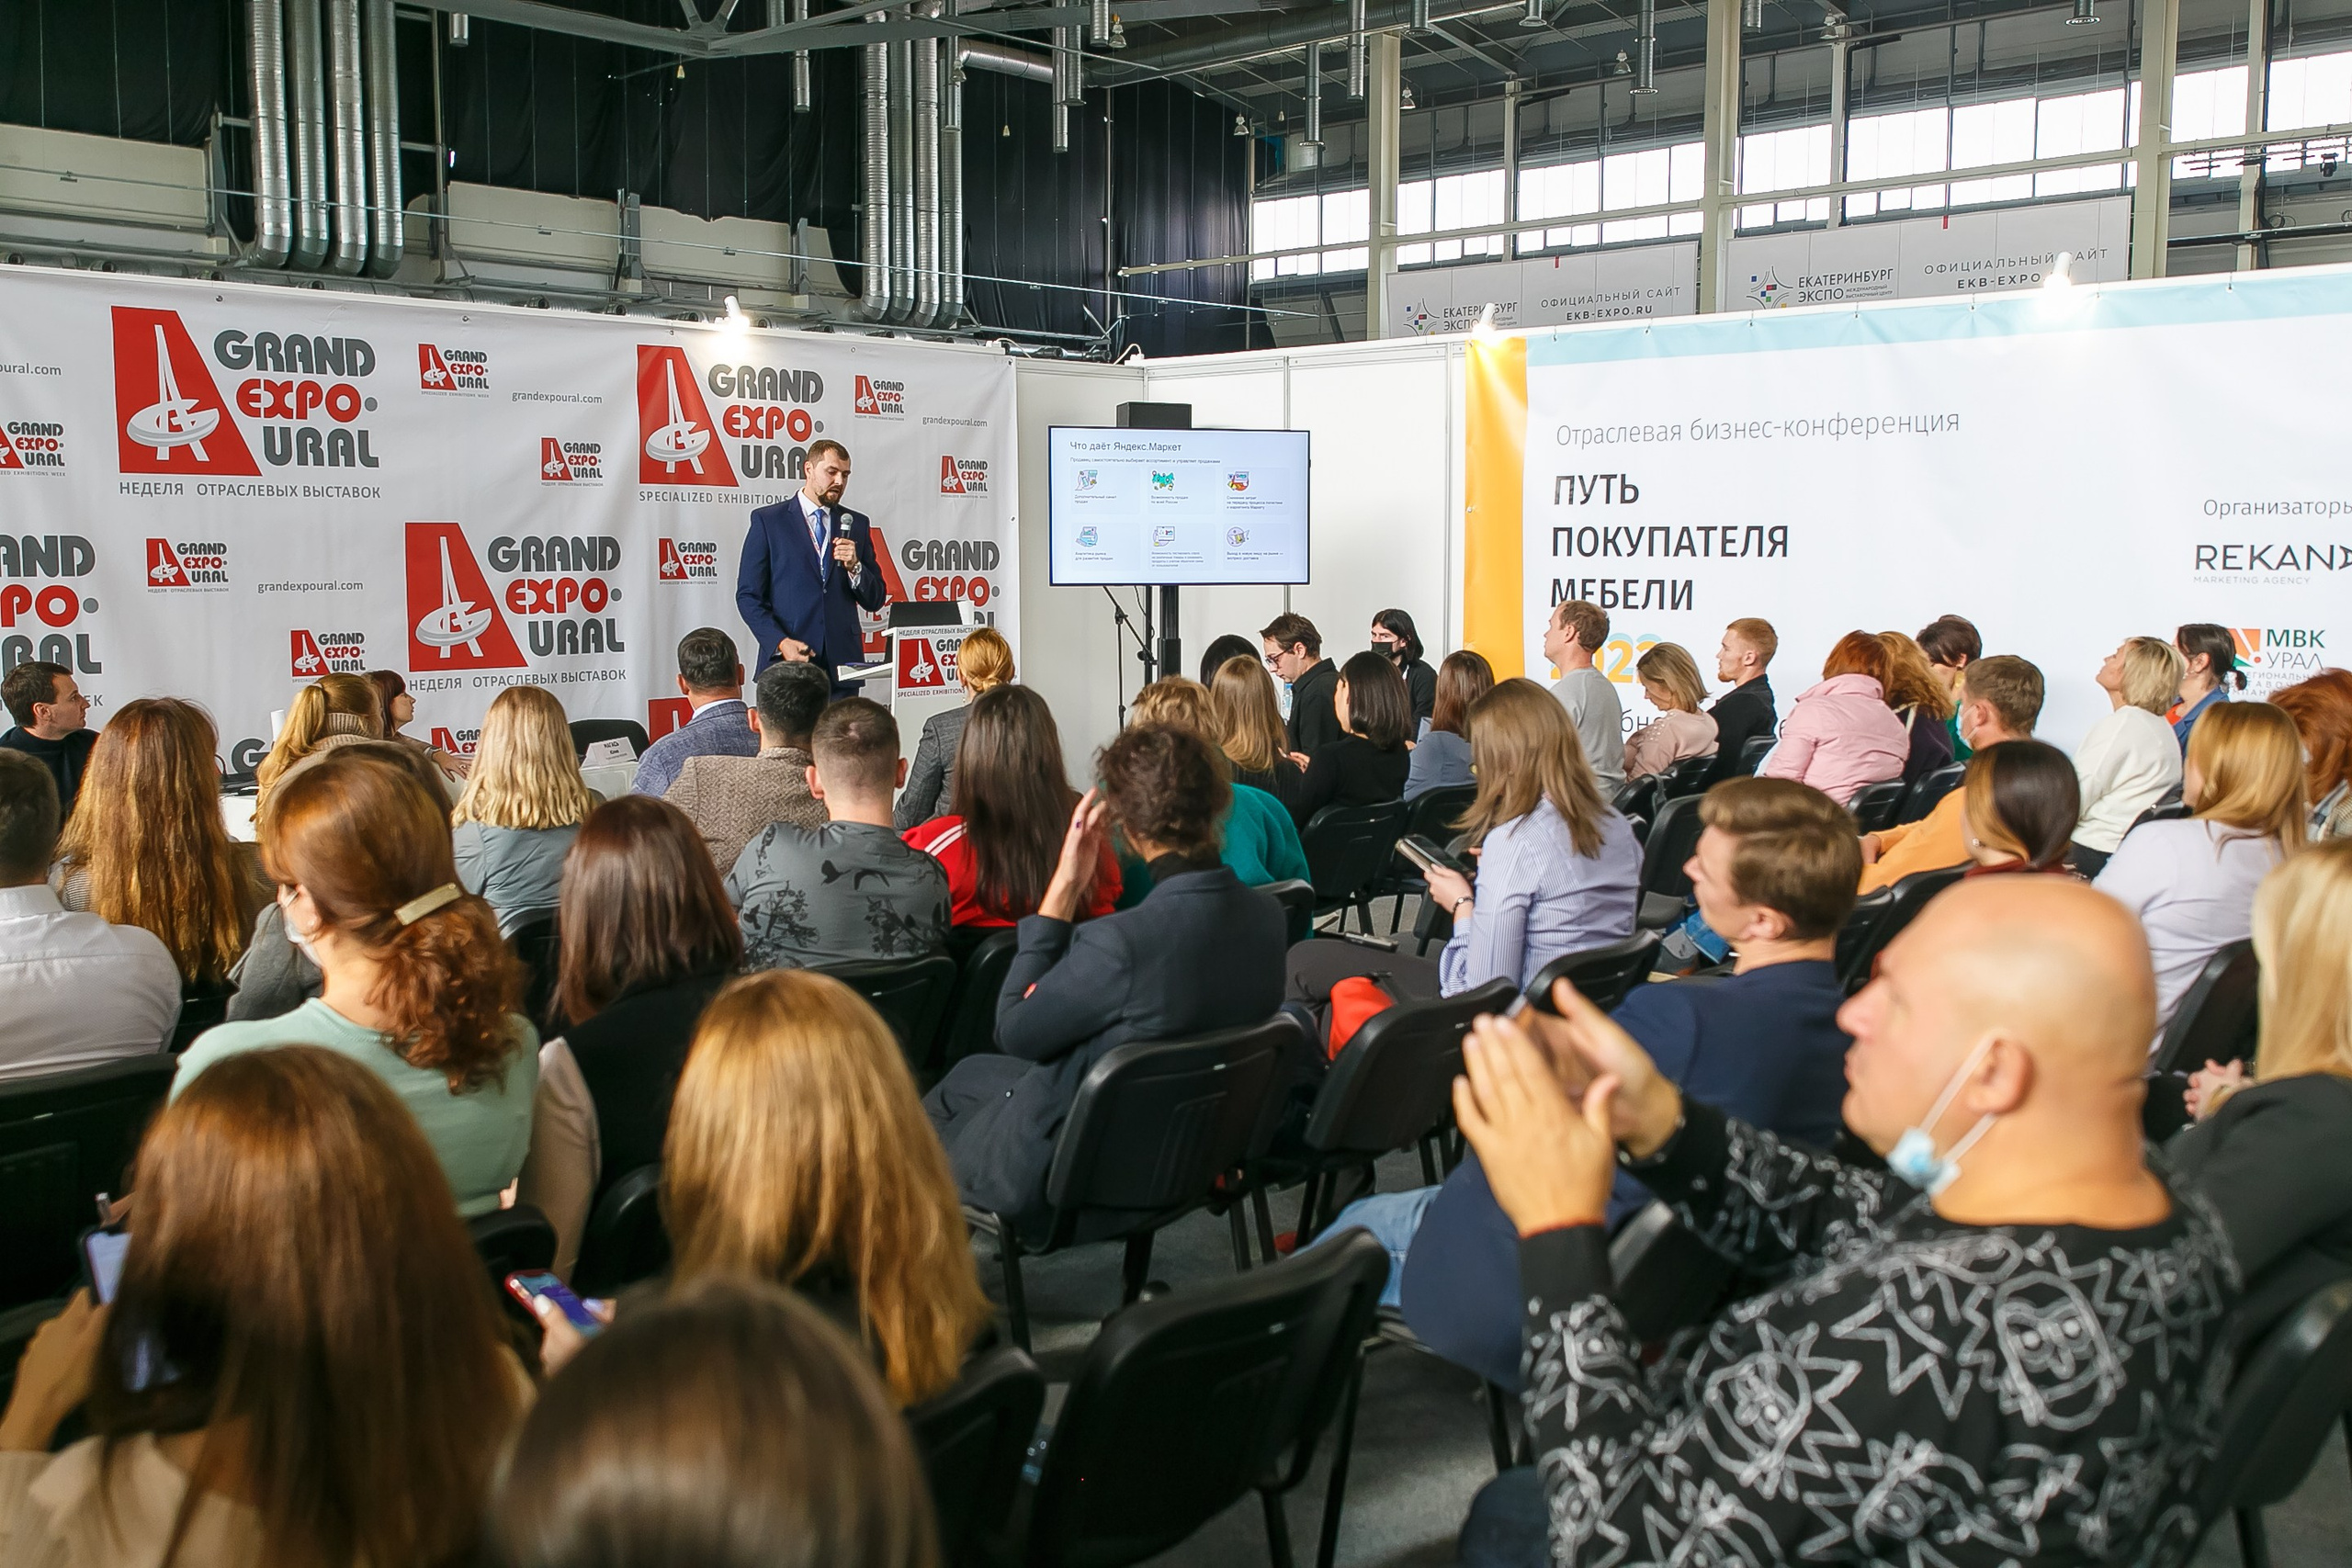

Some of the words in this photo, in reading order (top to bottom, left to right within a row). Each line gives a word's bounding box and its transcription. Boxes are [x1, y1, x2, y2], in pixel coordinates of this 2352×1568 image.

[1924, 252, 2054, 275] ОФИЦИАЛЬНЫЙ
[2071, 248, 2108, 263] АЙТ
[1799, 268, 1894, 288] ЕКАТЕРИНБУРГ
[1957, 273, 2041, 288] EKB-EXPO
[1541, 288, 1640, 309] ОФИЦИАЛЬНЫЙ
[1646, 286, 1681, 299] САЙТ
[1798, 288, 1844, 303] ЭКСПО
[1443, 301, 1518, 318] ЕКАТЕРИБУРГ
[1566, 305, 1654, 321] EKB-EXPO.RU
[213, 329, 377, 378] GRAND
[444, 349, 488, 364] GRAND
[458, 377, 489, 389] URAL
[707, 364, 824, 403] GRAND
[873, 380, 904, 391] GRAND
[512, 390, 603, 404] grandexpoural.com
[880, 402, 904, 413] URAL
[7, 422, 64, 436] GRAND
[922, 415, 988, 428] grandexpoural.com
[1556, 423, 1681, 450] Отраслевая
[1690, 412, 1961, 441] бизнес-конференция
[263, 426, 379, 468] URAL
[563, 443, 601, 454] GRAND
[1069, 441, 1088, 450] Что
[1090, 441, 1111, 452] даёт
[1114, 442, 1182, 452] Яндекс.Маркет
[24, 452, 65, 467] URAL
[741, 445, 807, 479] URA
[957, 459, 989, 470] GRAND
[573, 467, 603, 479] URAL
[119, 481, 184, 499] НЕДЕЛЯ
[197, 482, 299, 498] ОТРАСЛЕВЫХ
[303, 485, 380, 498] ВЫСТАВОК
[967, 481, 988, 492] URAL
[1553, 474, 1640, 505] ПУТЬ
[639, 491, 713, 503] SPECIALIZED
[176, 543, 228, 555] GRAND
[678, 542, 717, 553] GRAND
[1552, 525, 1789, 558] ПОКУПАТЕЛЯ
[487, 536, 621, 573] GRAND
[901, 540, 1000, 571] GRAND
[191, 570, 229, 582] URAL
[689, 566, 718, 577] URAL
[257, 581, 364, 593] grandexpoural.com
[2193, 576, 2258, 584] MARKETING
[2263, 577, 2312, 585] AGENCY
[1550, 579, 1693, 611] МЕБЕЛИ
[318, 632, 366, 645] GRAND
[527, 617, 625, 657] URAL
[2267, 628, 2326, 649] МВК
[331, 660, 366, 672] URAL
[2267, 652, 2324, 671] УРАЛ
[409, 678, 462, 693] НЕДЕЛЯ
[472, 672, 558, 687] ОТРАСЛЕВЫХ
[560, 670, 627, 683] ВЫСТАВОК
[933, 687, 965, 695] EXHIBITIONS
